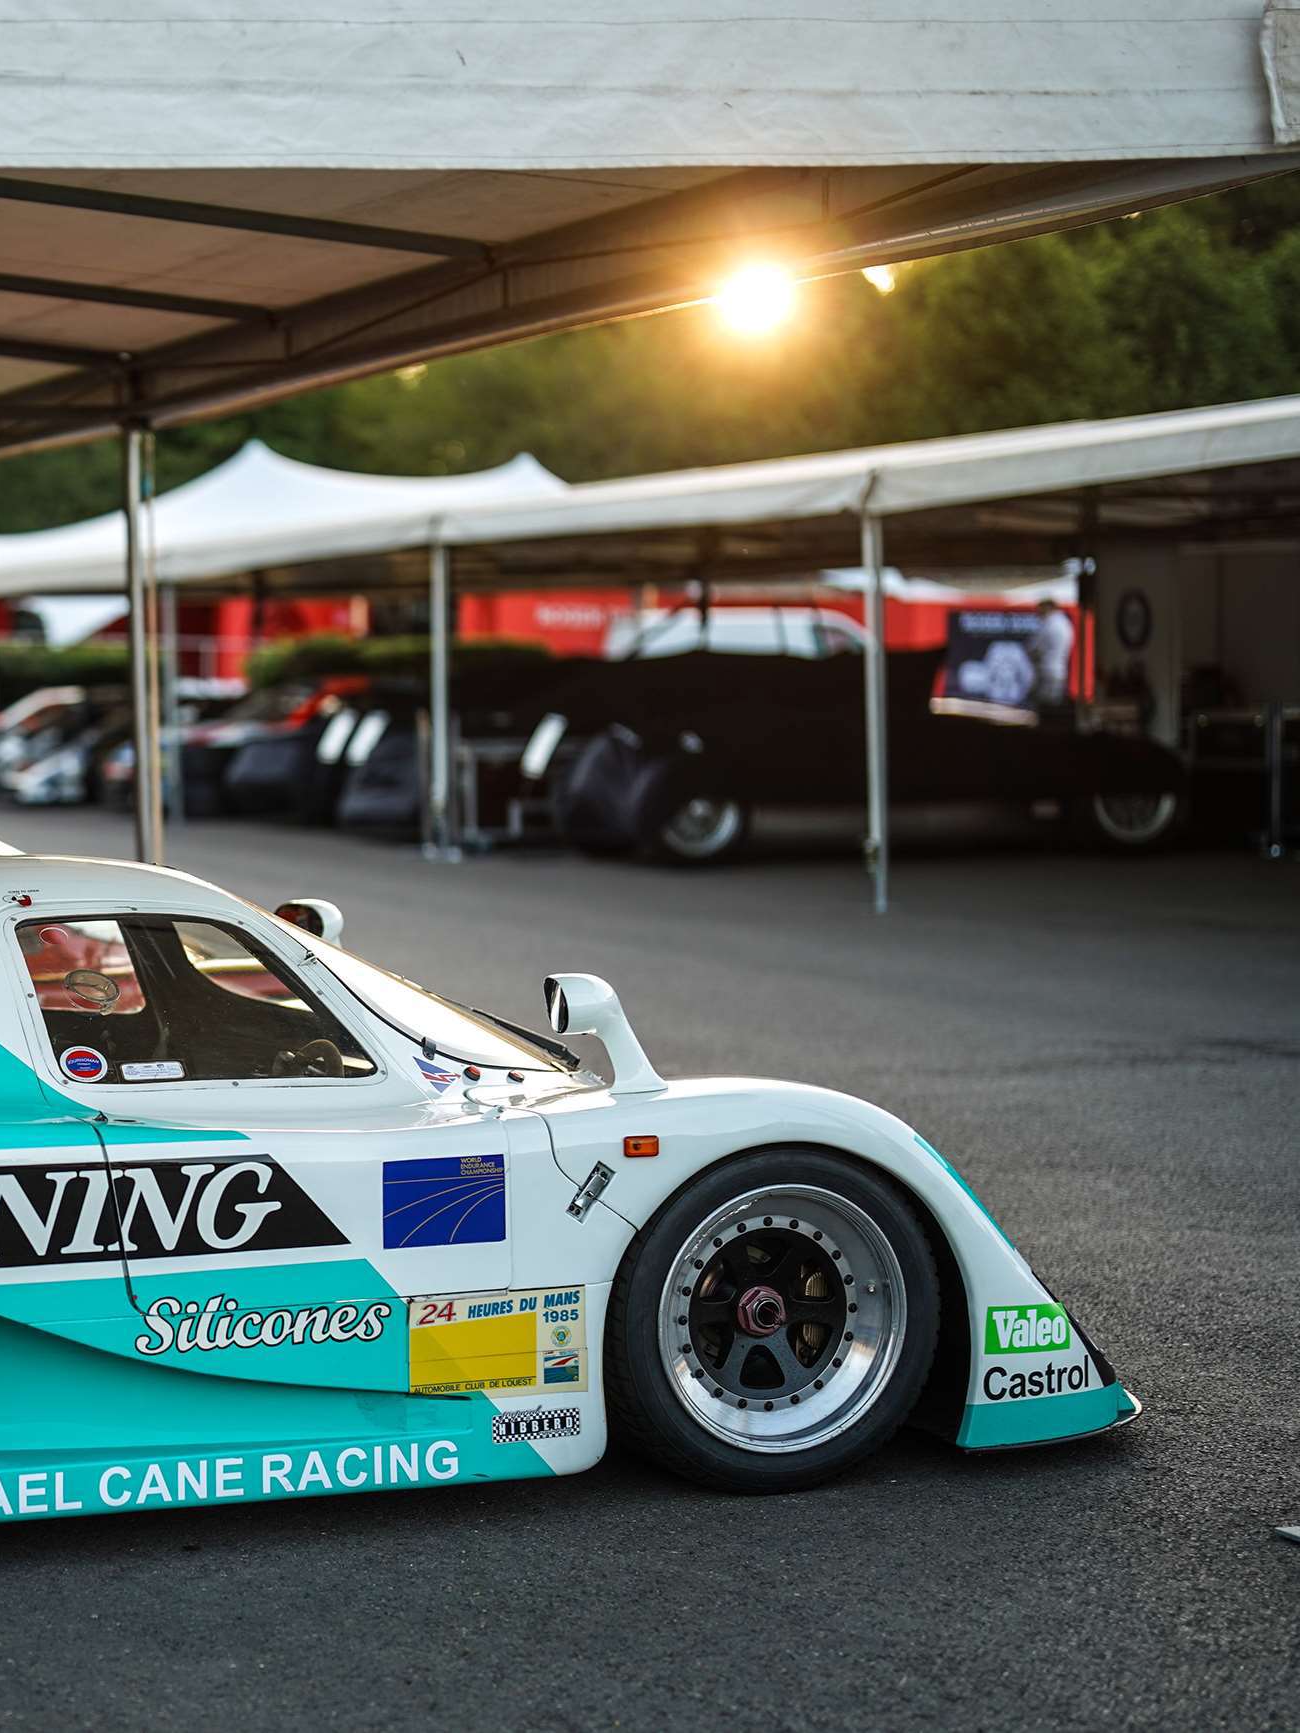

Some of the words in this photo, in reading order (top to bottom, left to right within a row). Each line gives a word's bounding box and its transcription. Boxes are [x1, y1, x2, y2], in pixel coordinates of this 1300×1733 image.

[135, 1293, 392, 1354] Silicones
[418, 1301, 457, 1326] 24
[468, 1299, 513, 1319] HEURES
[519, 1297, 538, 1312] DU
[543, 1290, 581, 1309] MANS
[542, 1308, 580, 1323] 1985
[992, 1309, 1067, 1349] Valeo
[413, 1384, 461, 1394] AUTOMOBILE
[464, 1380, 486, 1390] CLUB
[489, 1381, 500, 1389] DE
[983, 1354, 1089, 1401] Castrol
[497, 1416, 574, 1436] HIBBERD
[98, 1457, 244, 1508] CANE
[262, 1439, 460, 1493] RACING
